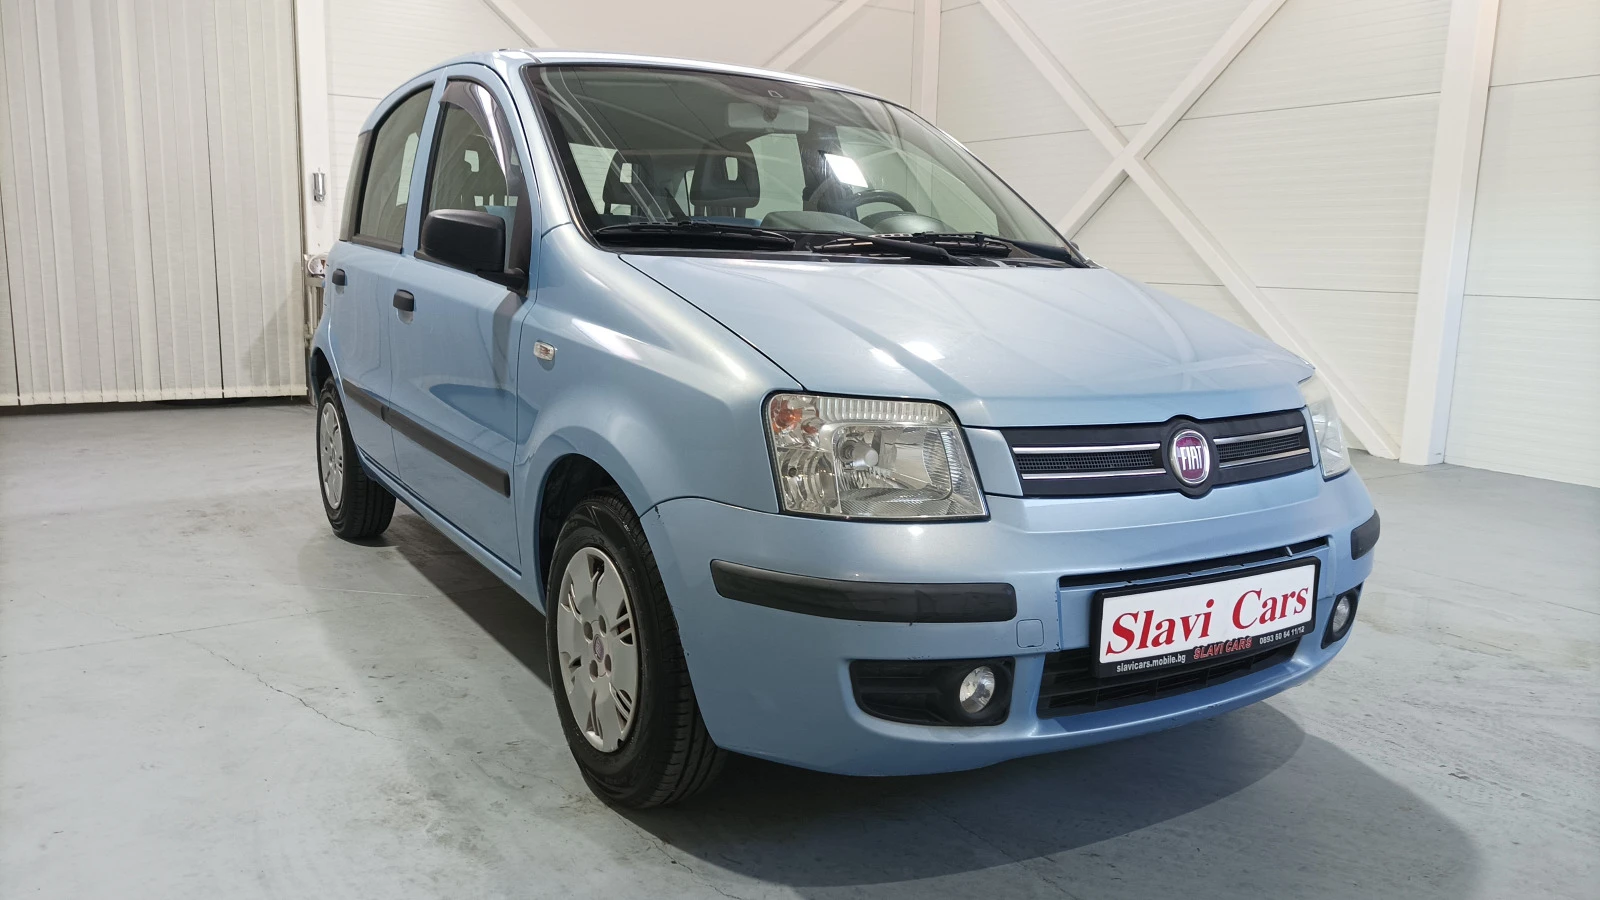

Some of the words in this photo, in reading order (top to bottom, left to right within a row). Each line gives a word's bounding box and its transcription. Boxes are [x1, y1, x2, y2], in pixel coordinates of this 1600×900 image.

[1180, 445, 1202, 471] FIAT
[1105, 598, 1215, 656] Slavi
[1231, 587, 1310, 630] Cars
[1193, 642, 1225, 660] SLAVI
[1225, 636, 1253, 653] CARS
[1116, 653, 1187, 673] slavicars.mobile.bg
